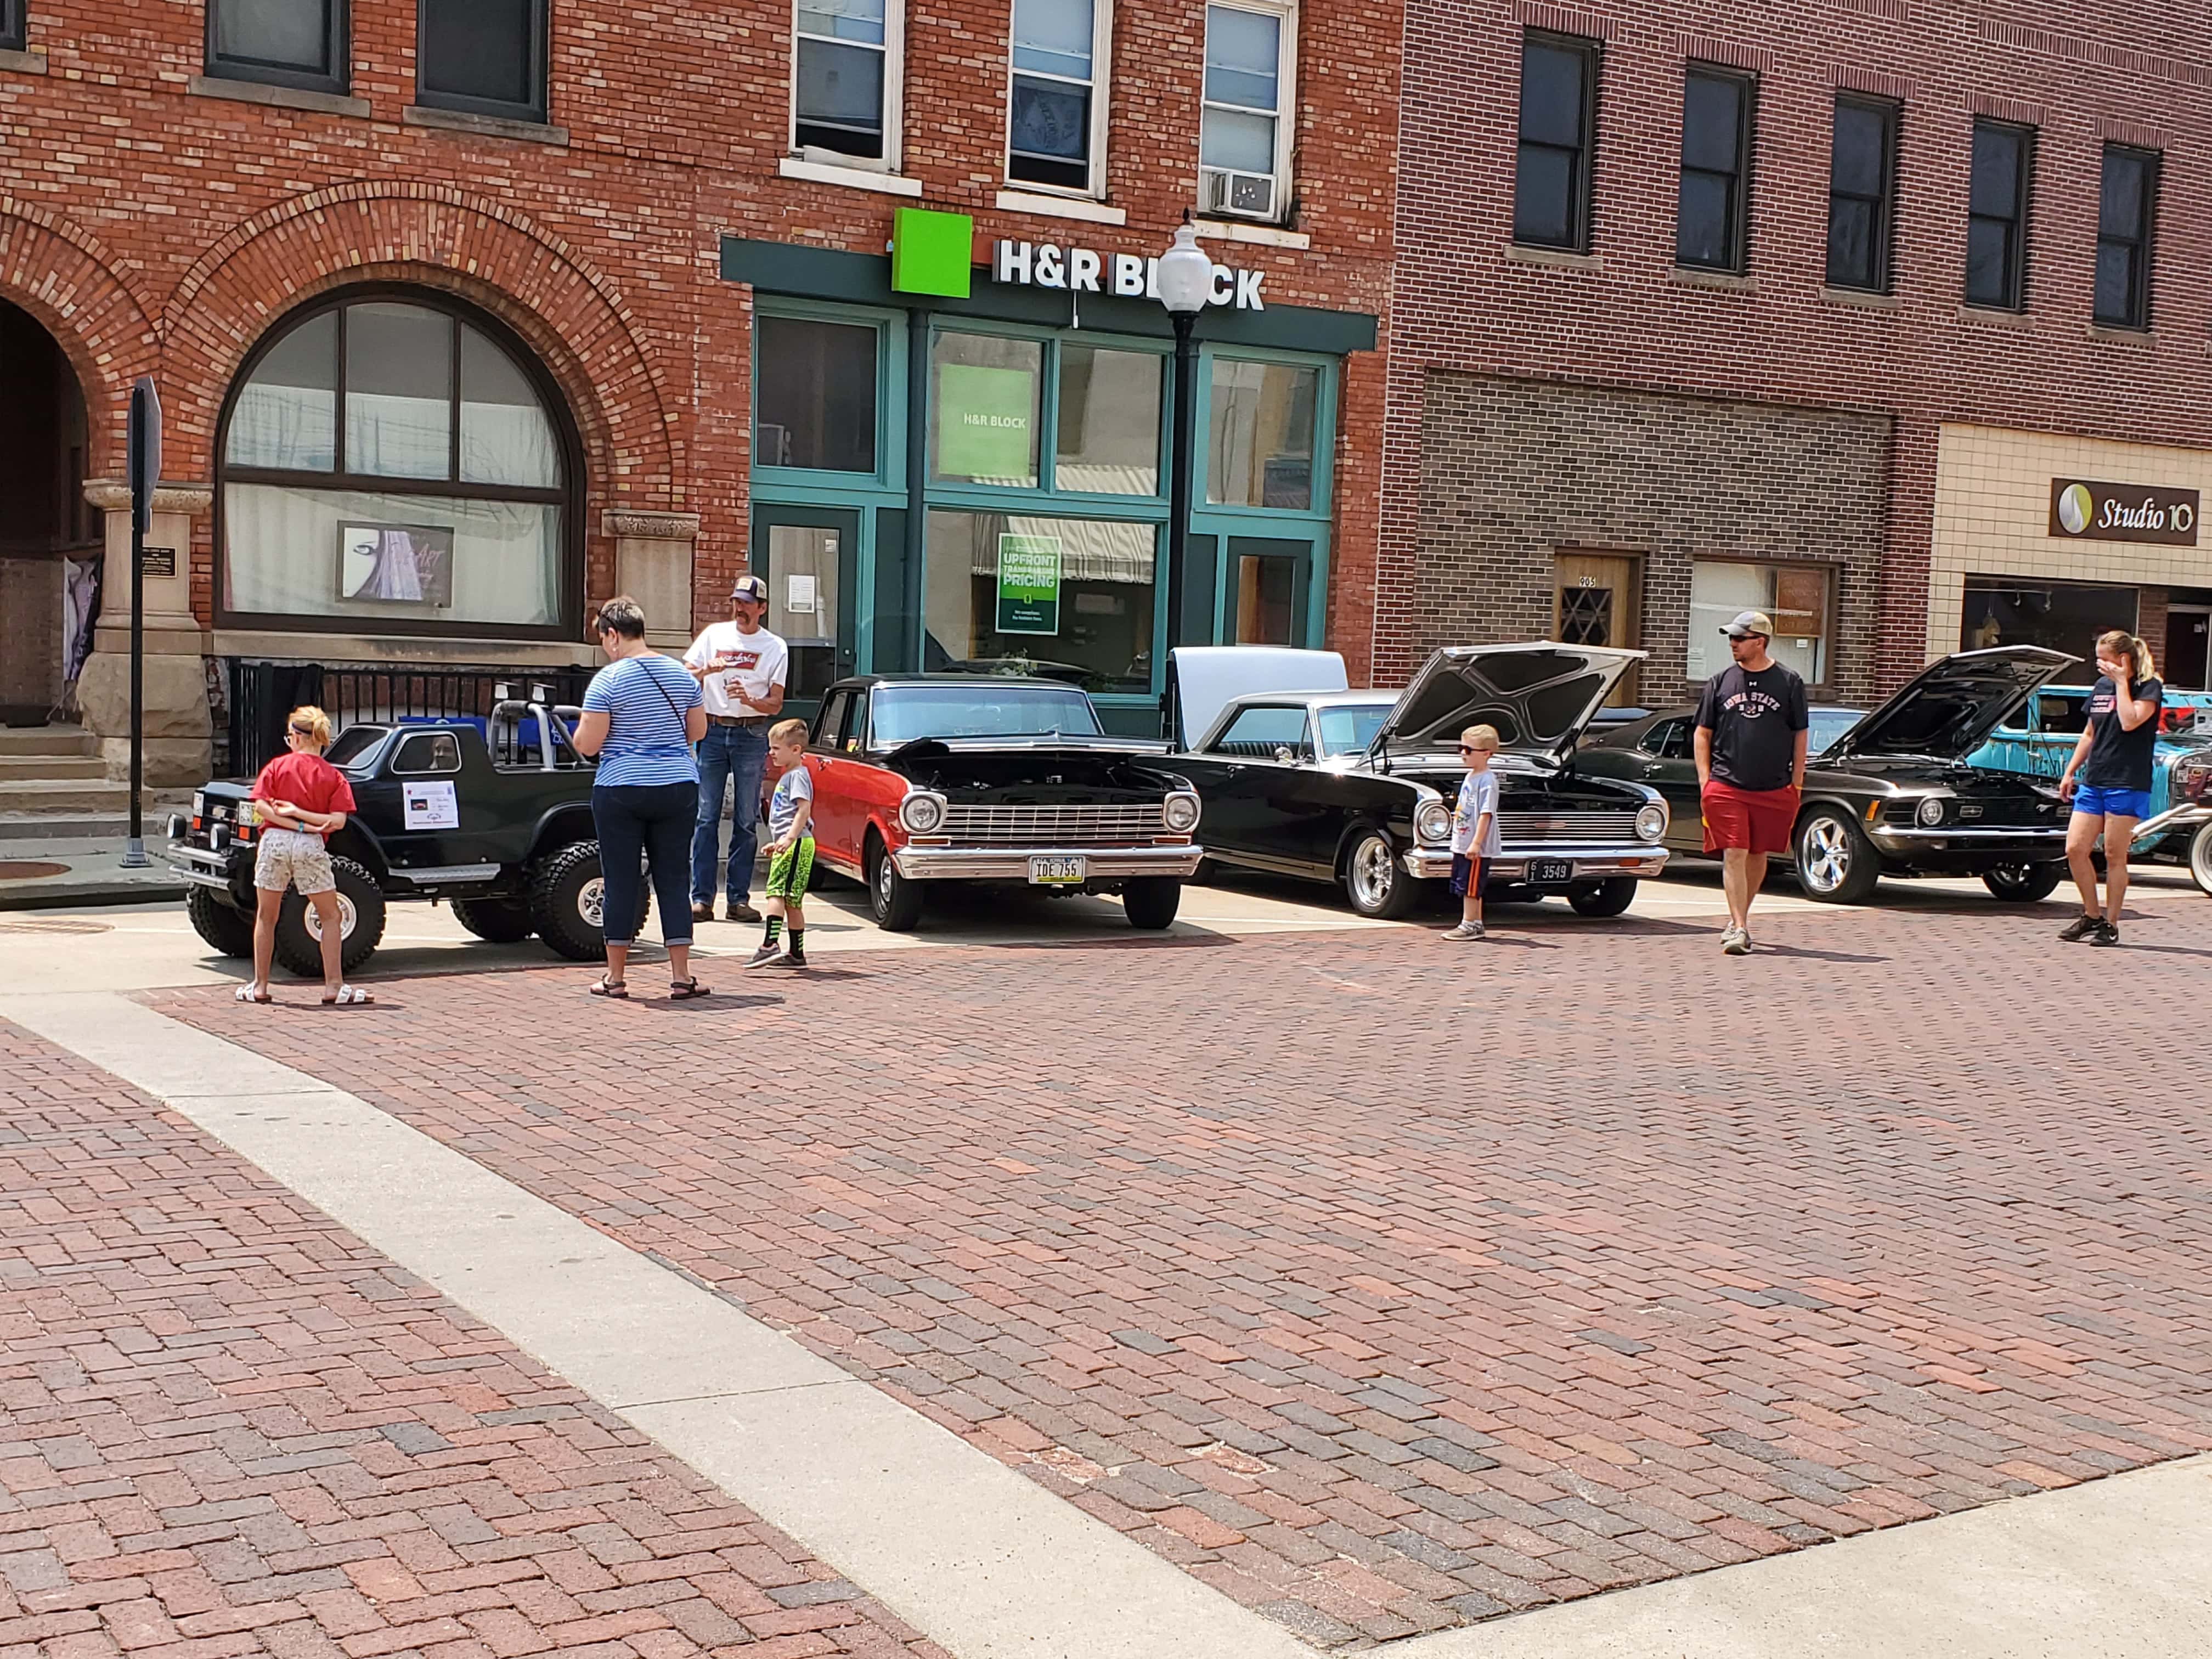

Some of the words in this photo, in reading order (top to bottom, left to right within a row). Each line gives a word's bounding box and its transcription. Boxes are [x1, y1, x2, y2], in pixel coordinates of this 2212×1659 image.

[998, 239, 1101, 292] H&R
[1115, 253, 1266, 312] BLCK
[964, 413, 987, 426] H&R
[991, 416, 1026, 429] BLOCK
[2098, 498, 2165, 530] Studio
[2168, 503, 2194, 532] 10
[1003, 552, 1056, 567] UPFRONT
[1003, 574, 1055, 588] PRICING
[1579, 576, 1595, 586] 905
[1723, 692, 1748, 710] IOWA
[1751, 691, 1781, 711] STATE
[1036, 864, 1055, 877] IDE
[1059, 864, 1077, 877] 755
[1542, 865, 1567, 879] 3549
